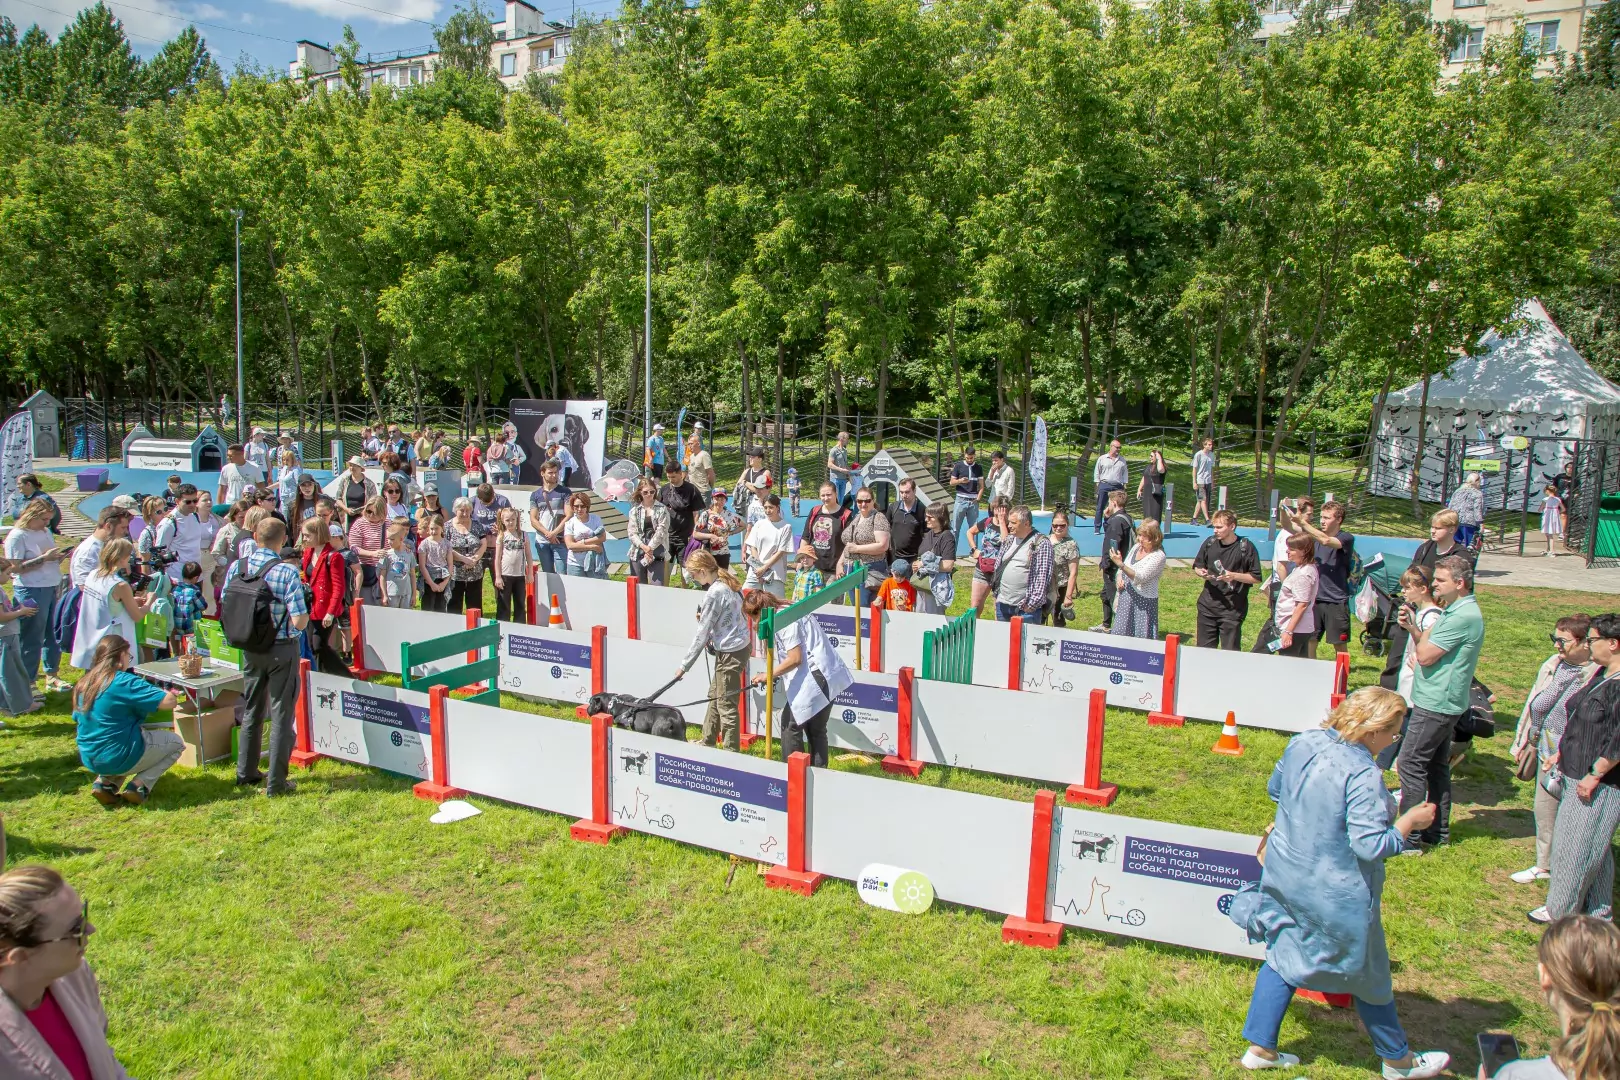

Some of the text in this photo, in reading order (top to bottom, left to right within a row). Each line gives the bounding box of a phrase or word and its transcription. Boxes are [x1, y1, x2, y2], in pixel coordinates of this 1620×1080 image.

[1063, 641, 1101, 652] Российская
[1084, 652, 1123, 661] подготовки
[659, 755, 706, 773] Российская
[658, 774, 741, 799] собак-проводников
[659, 765, 734, 789] школа подготовки
[1130, 839, 1199, 859] Российская
[1128, 860, 1248, 888] собак-проводников
[1129, 851, 1239, 876] школа подготовки
